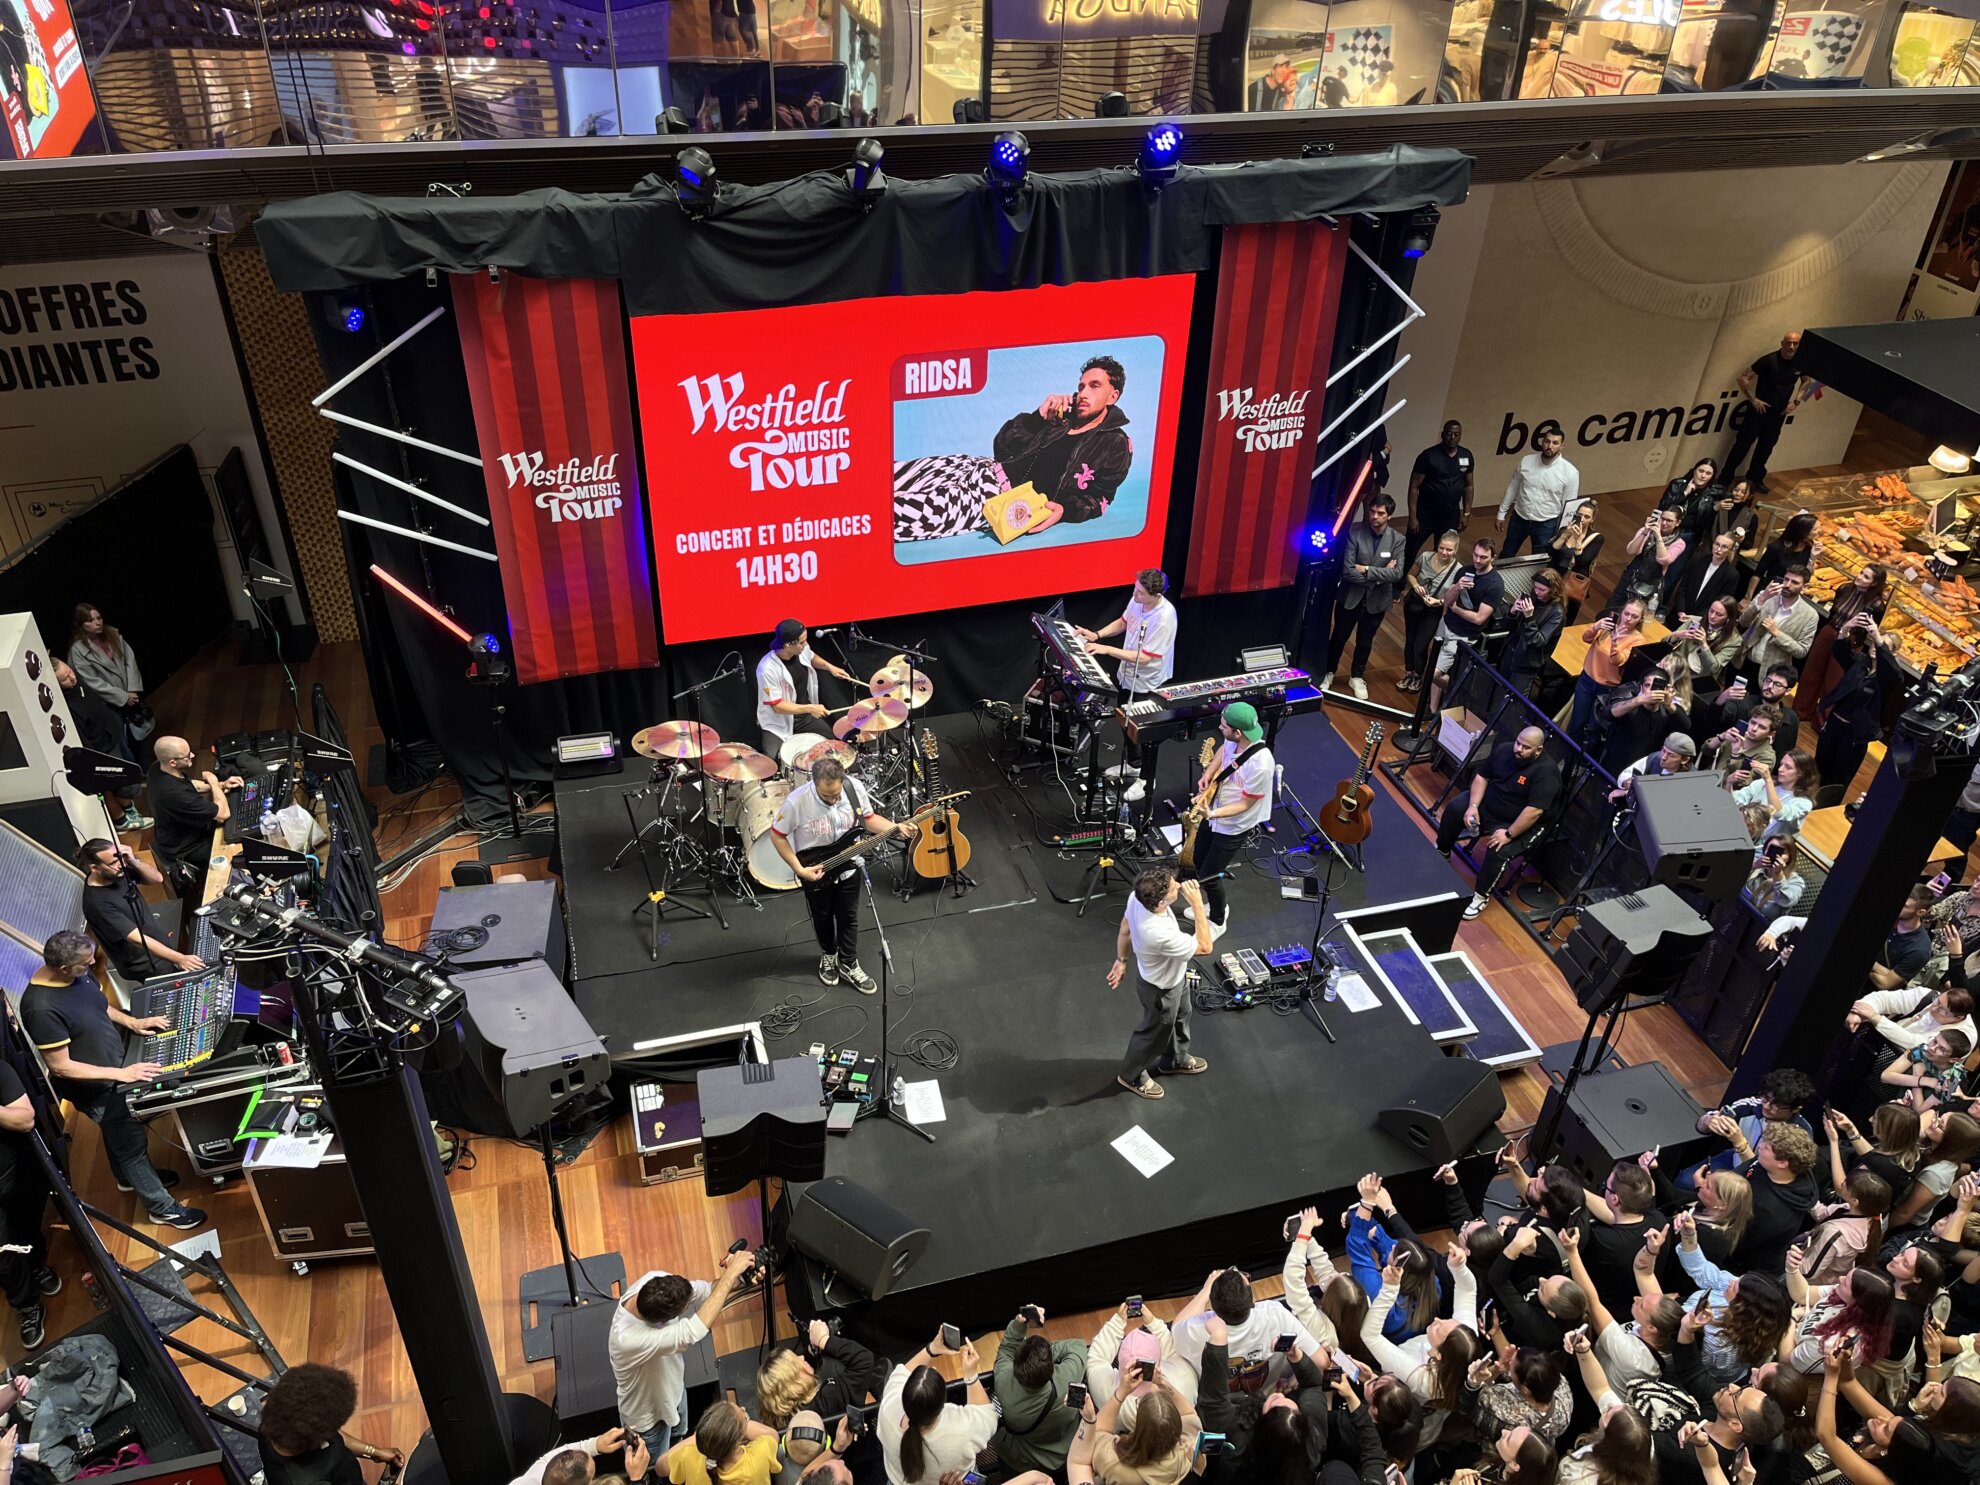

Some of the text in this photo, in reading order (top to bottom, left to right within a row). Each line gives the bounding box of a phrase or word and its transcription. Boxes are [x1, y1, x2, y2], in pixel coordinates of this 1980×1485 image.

[0, 279, 147, 335] OFFRES
[0, 336, 160, 392] DIANTES
[905, 357, 972, 394] RIDSA
[677, 371, 852, 435] Westfield
[1216, 387, 1312, 421] Westfield
[788, 427, 850, 454] MUSIC
[1236, 418, 1303, 453] Tour
[1270, 416, 1305, 431] MUSIC
[1496, 390, 1794, 456] be camaïe.
[497, 451, 619, 489] Westfield
[729, 429, 851, 492] Tour
[535, 484, 623, 522] Tour
[576, 482, 621, 500] MUSIC
[676, 514, 872, 554] CONCERT ET DÉDICACES
[736, 550, 818, 588] 14H30
